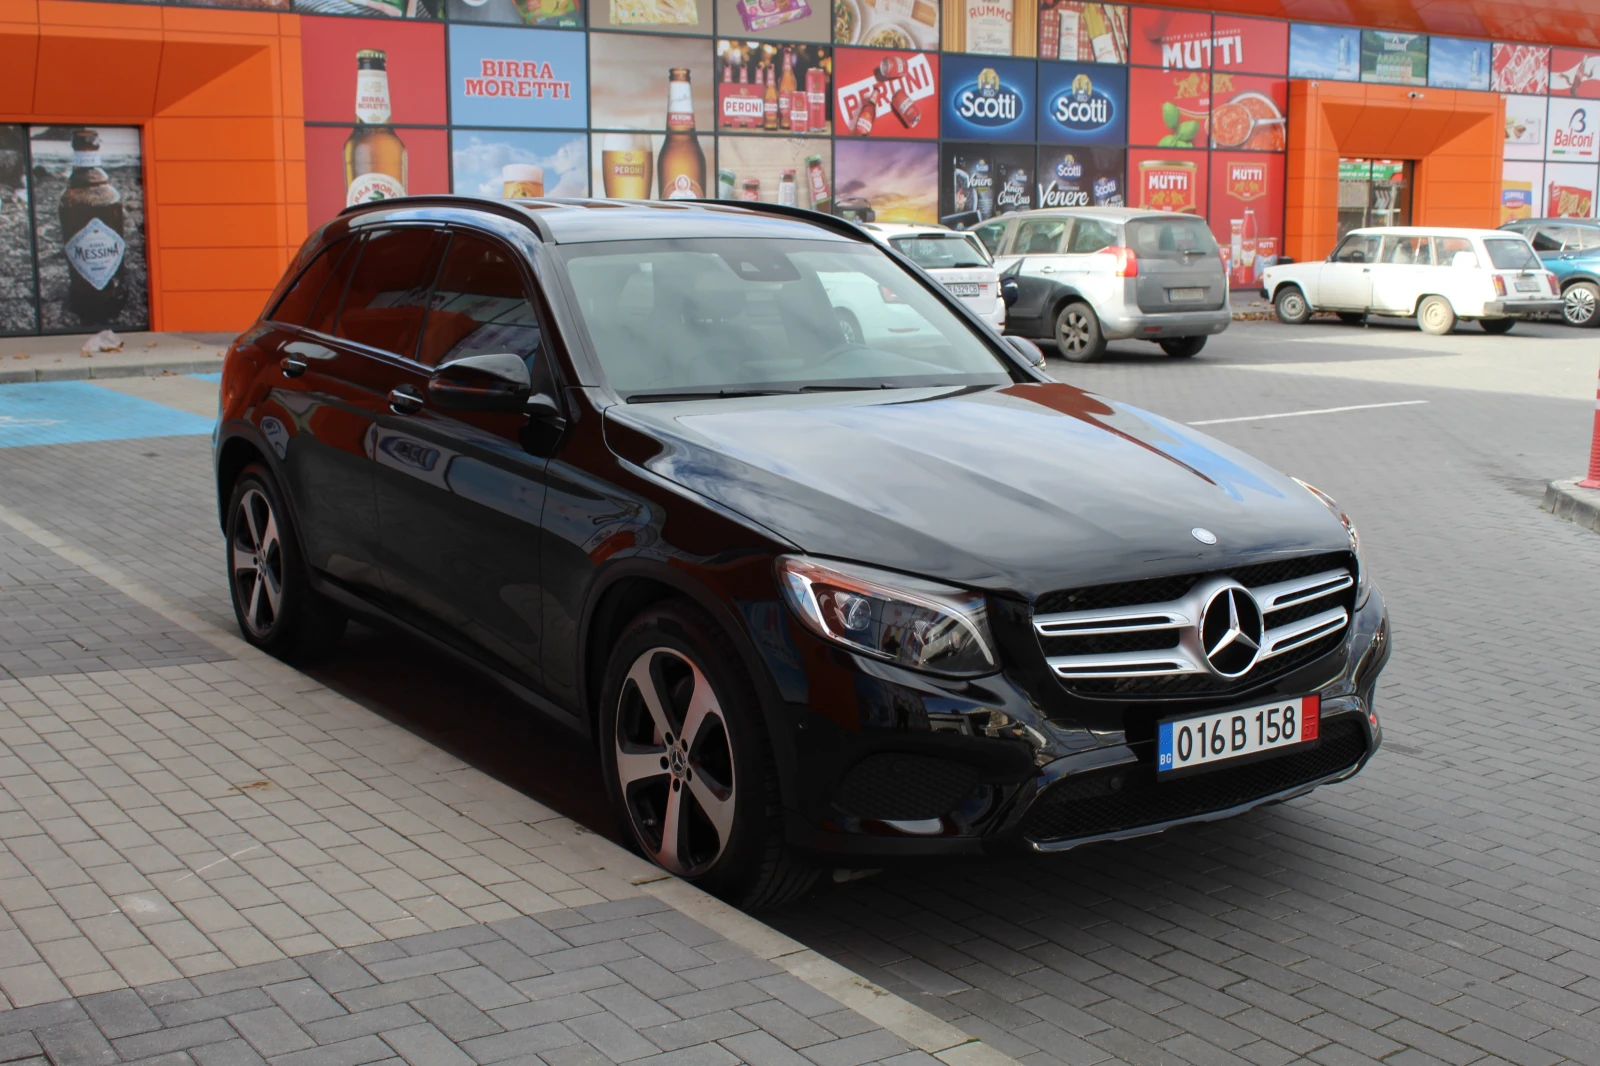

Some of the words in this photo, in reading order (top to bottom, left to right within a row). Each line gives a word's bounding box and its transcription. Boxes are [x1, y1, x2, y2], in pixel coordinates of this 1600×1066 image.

[969, 5, 1014, 22] RUMMO
[1162, 35, 1243, 73] MUTTI
[481, 58, 554, 79] BIRRA
[464, 79, 571, 99] MORETTI
[726, 101, 762, 113] PERONI
[961, 92, 1016, 119] Scotti
[1056, 97, 1107, 123] Scotti
[1554, 127, 1595, 147] Balconi
[614, 165, 643, 175] PERONI
[1058, 164, 1082, 177] Scotti
[1232, 167, 1263, 180] MUTTI
[1095, 180, 1117, 197] Scotti
[1148, 174, 1188, 190] MUTTI
[1038, 180, 1089, 209] Venere
[74, 240, 120, 262] MESSINA
[1303, 723, 1315, 737] 27
[1160, 753, 1172, 765] BG
